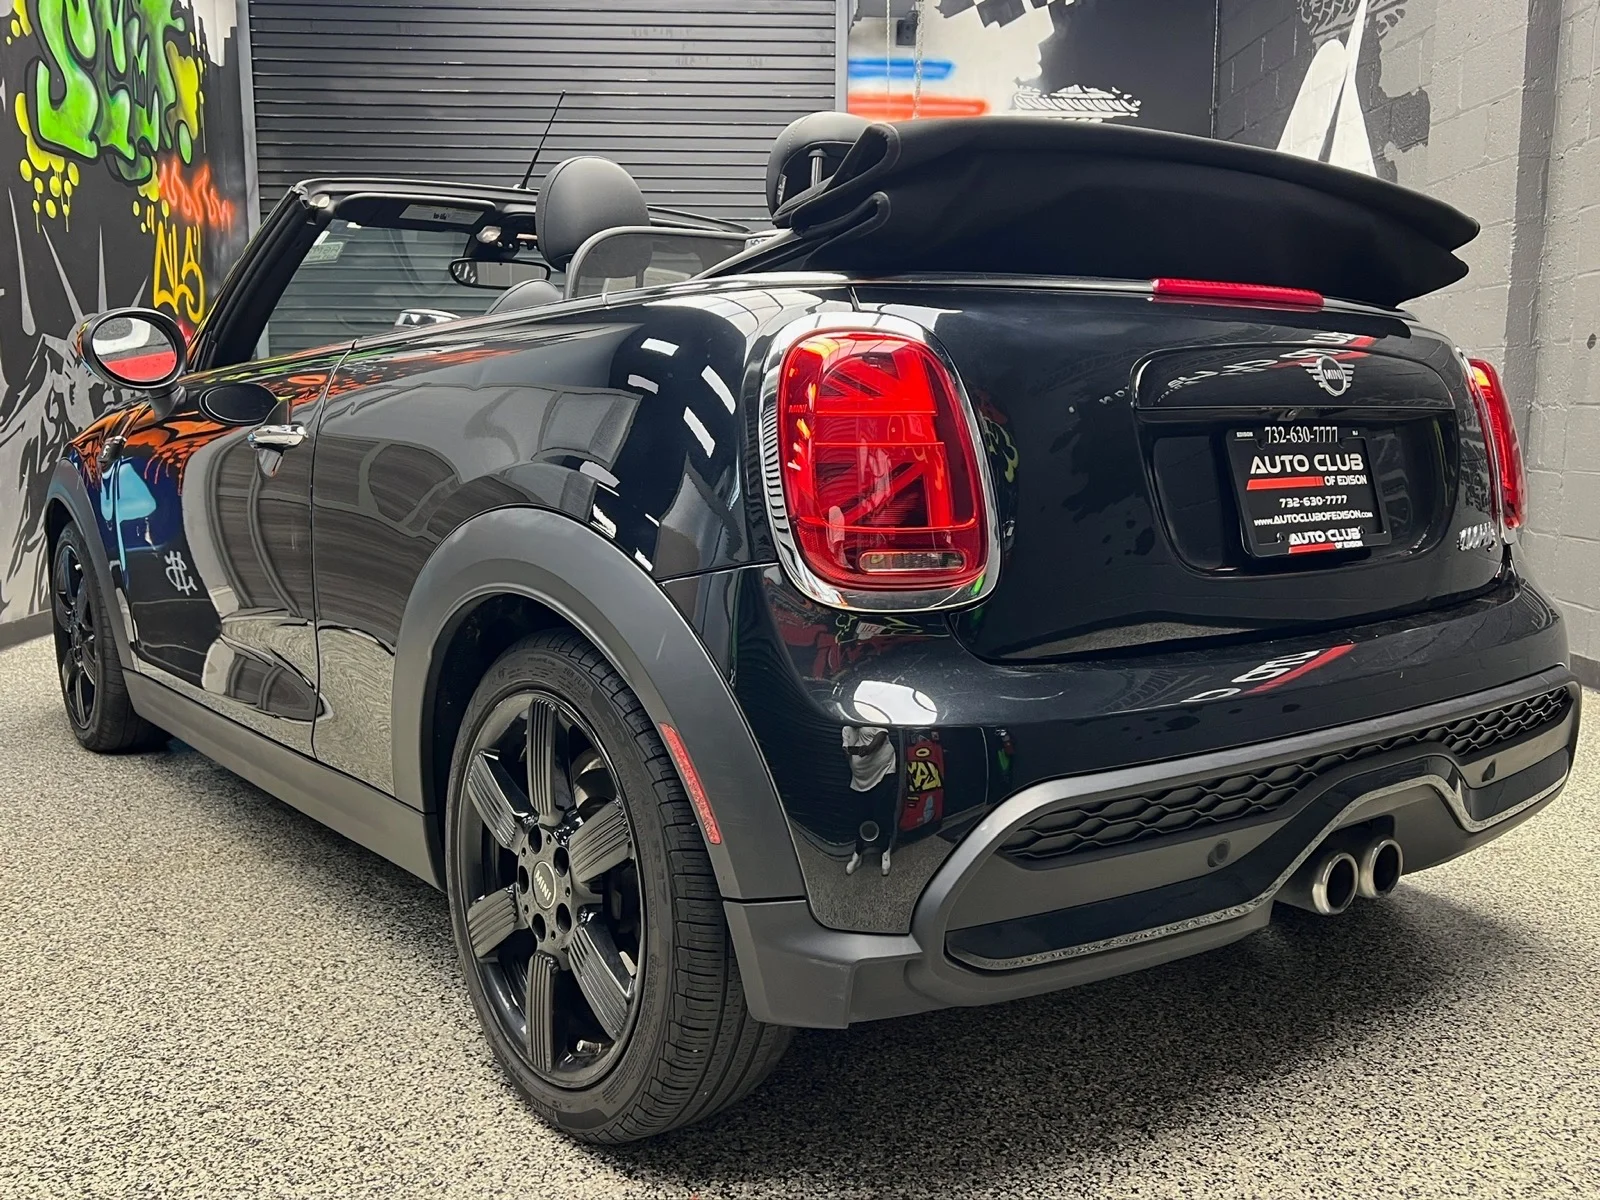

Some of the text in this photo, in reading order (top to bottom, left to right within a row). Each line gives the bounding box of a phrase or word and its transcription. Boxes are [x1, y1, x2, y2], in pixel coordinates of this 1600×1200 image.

[1323, 369, 1343, 379] MINI
[1264, 426, 1338, 444] 732-630-7777
[1250, 453, 1364, 475] AUTO CLUB
[1324, 474, 1368, 486] OF EDISON
[1279, 495, 1347, 508] 732-630-7777
[1289, 527, 1361, 545] AUTO CLUB
[535, 869, 552, 901] MINI
